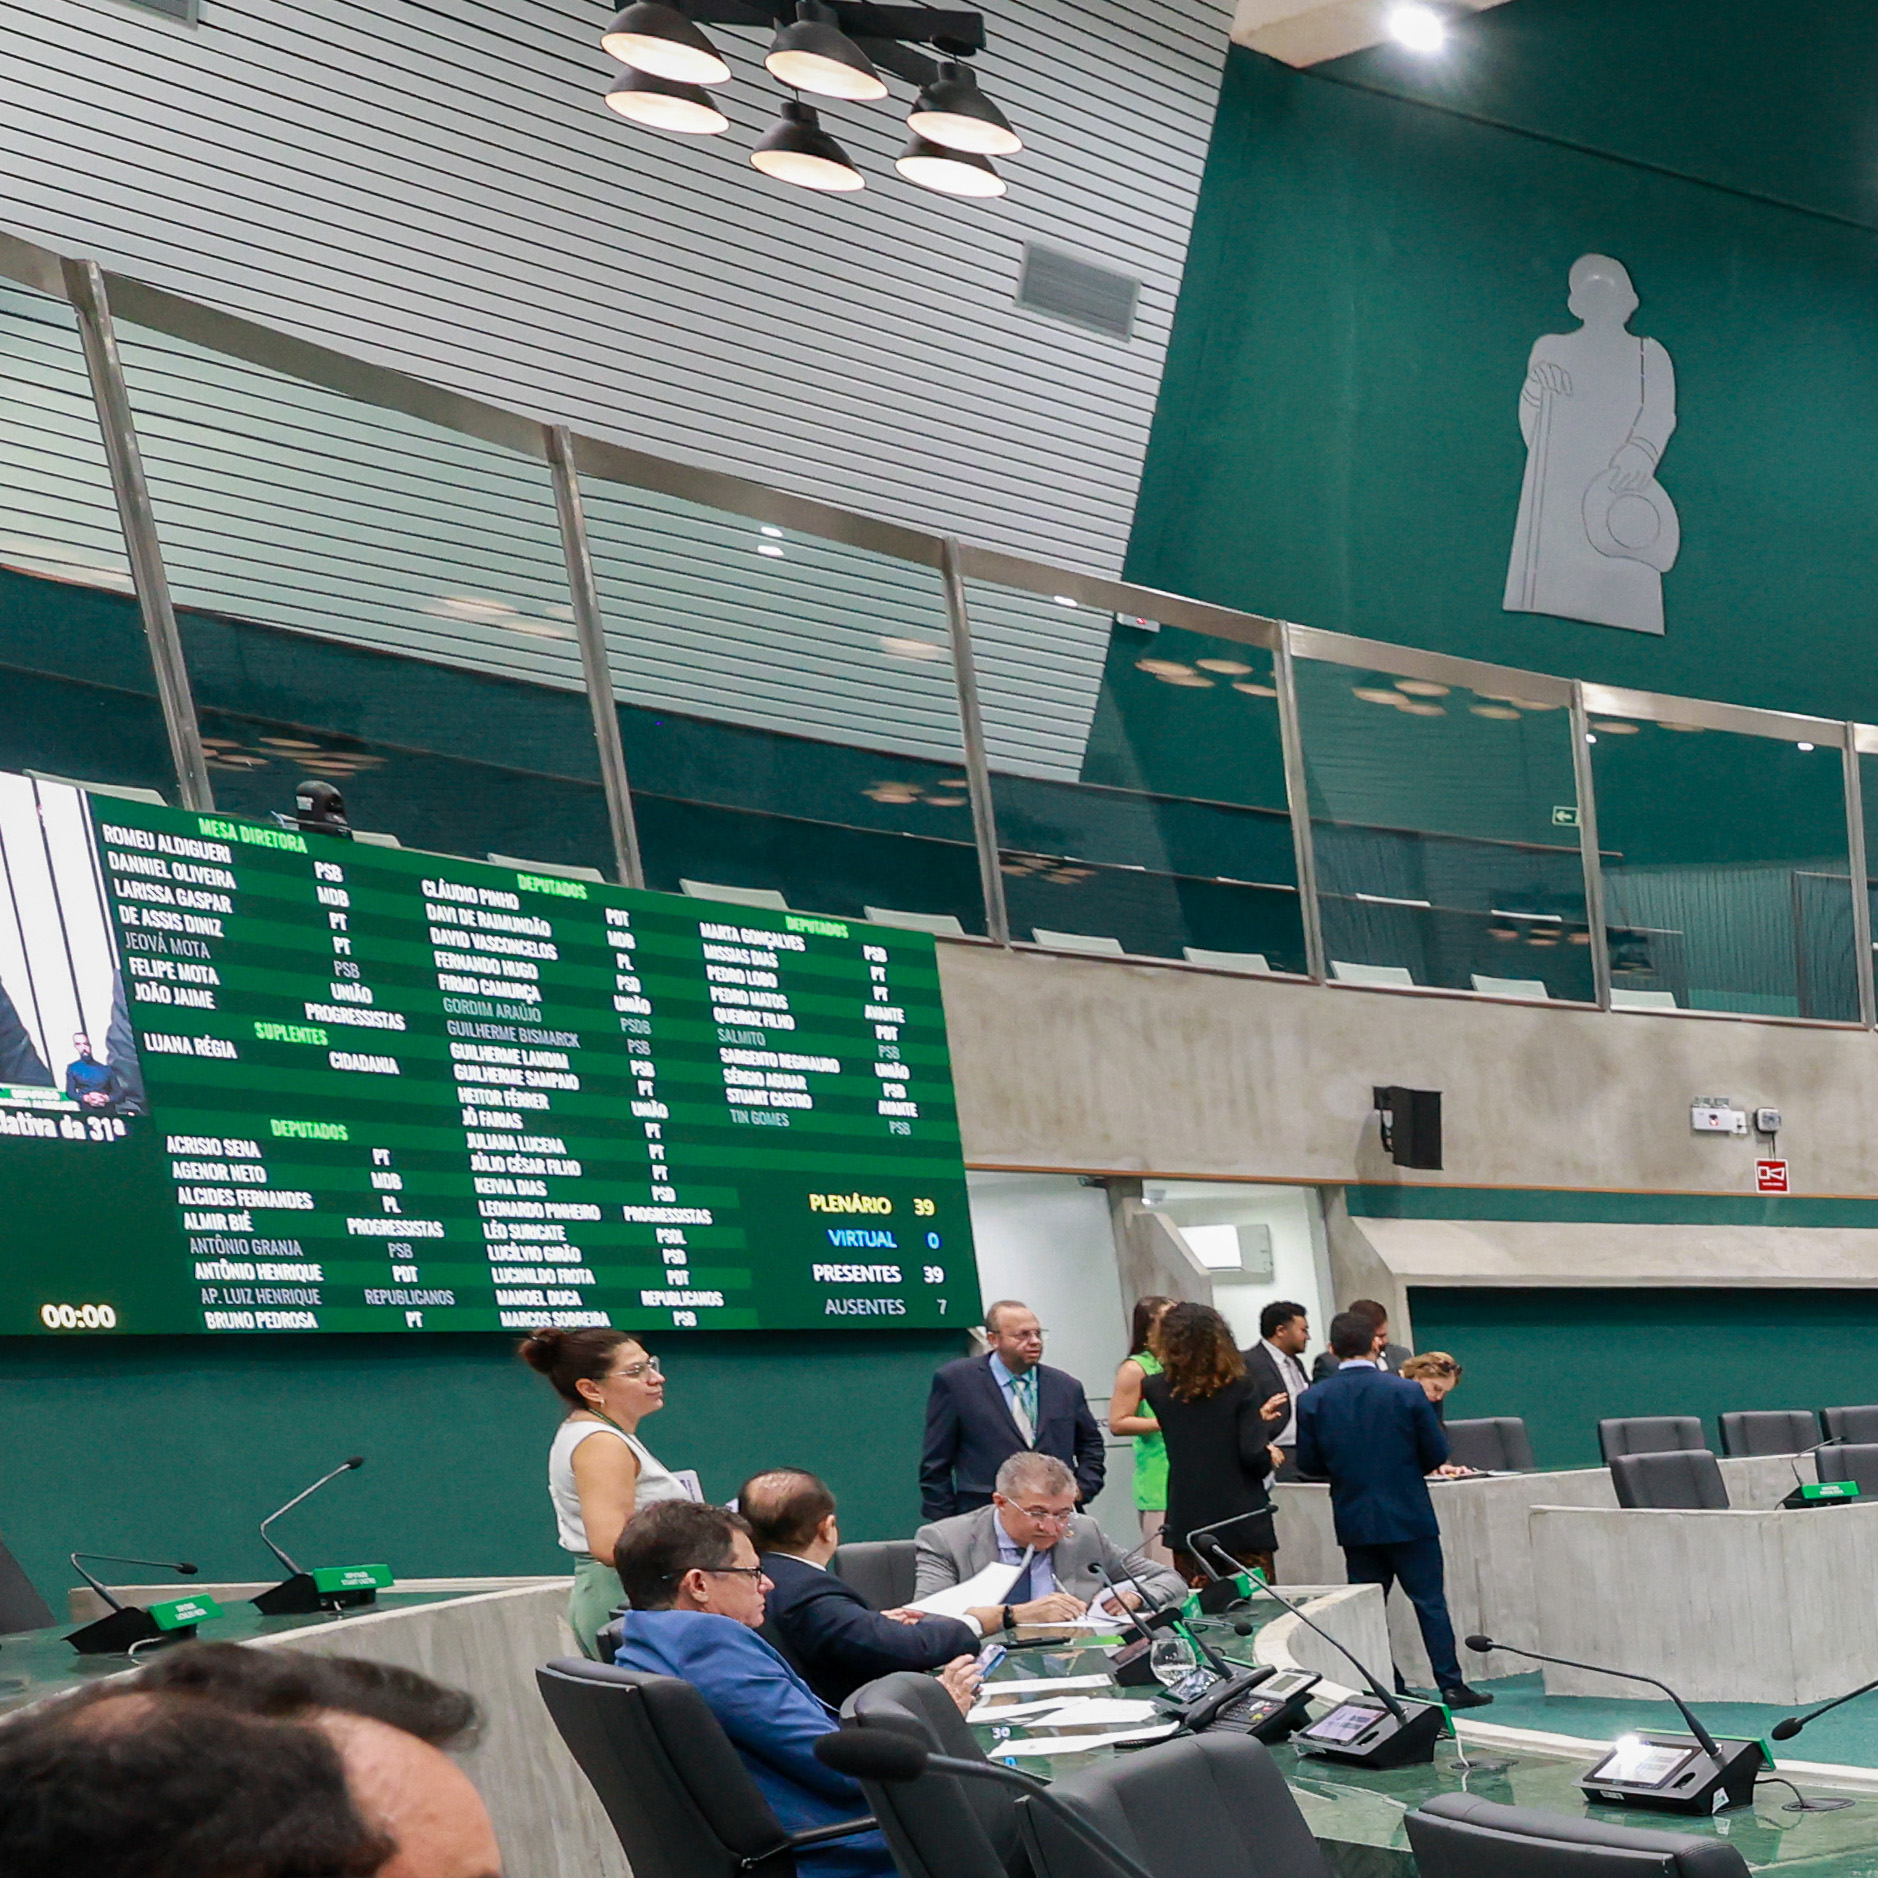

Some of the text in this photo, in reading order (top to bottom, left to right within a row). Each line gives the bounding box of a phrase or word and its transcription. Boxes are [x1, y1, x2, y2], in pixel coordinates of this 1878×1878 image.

[102, 824, 232, 864] ROMEU ALDIGUERI
[198, 818, 308, 853] MESA DIRETORA
[171, 862, 237, 889] OLIVEIRA
[314, 861, 343, 882] PSB
[113, 878, 233, 914] LARISSA GASPAR
[316, 886, 350, 907] MDB
[118, 904, 224, 937] DE ASSIS DINIZ
[329, 912, 347, 931] PT
[125, 931, 211, 959] JEOVÁ MOTA
[333, 936, 351, 955] PT
[129, 957, 220, 985] FELIPE MOTA
[334, 960, 360, 979] PSB
[870, 966, 885, 982] PT
[134, 981, 216, 1009] JOÃO JAIME
[330, 982, 373, 1004] UNIÃO
[873, 986, 888, 1002] PT
[304, 1002, 406, 1031] PROGRESSISTAS
[255, 1022, 327, 1045] SUPLENTES
[143, 1032, 238, 1059] LUANA RÉGIA
[329, 1051, 400, 1075] CIDADANIA
[637, 1080, 654, 1096] PT
[60, 1114, 87, 1140] da
[271, 1120, 348, 1140] DEPUTADOS
[645, 1122, 661, 1139] PT
[223, 1138, 262, 1158] SENA
[372, 1148, 390, 1166] PT
[648, 1144, 664, 1160] PT
[172, 1161, 267, 1183] AGENOR NETO
[371, 1172, 402, 1190] MDB
[652, 1164, 668, 1181] PT
[178, 1186, 314, 1209] ALCIDES FERNANDES
[382, 1195, 402, 1213] PL
[809, 1193, 892, 1214] PLENÁRIO
[913, 1198, 936, 1216] 39
[184, 1212, 229, 1231] ALMIR
[347, 1218, 444, 1238] PROGRESSISTAS
[190, 1234, 249, 1255] ANTÔNIO
[828, 1229, 897, 1248] VIRTUAL
[928, 1232, 940, 1249] 0
[388, 1243, 413, 1258] PSB
[195, 1258, 324, 1283] ANTÔNIO HENRIQUE
[812, 1264, 902, 1283] PRESENTES
[923, 1266, 944, 1283] 39
[202, 1288, 322, 1306] AP. LUIZ HENRIQUE
[364, 1289, 455, 1305] REPUBLICANOS
[41, 1304, 116, 1328] 00:00
[825, 1299, 906, 1315] AUSENTES
[937, 1299, 947, 1315] 7
[204, 1311, 318, 1329] BRUNO PEDROSA
[405, 1311, 423, 1328] PT
